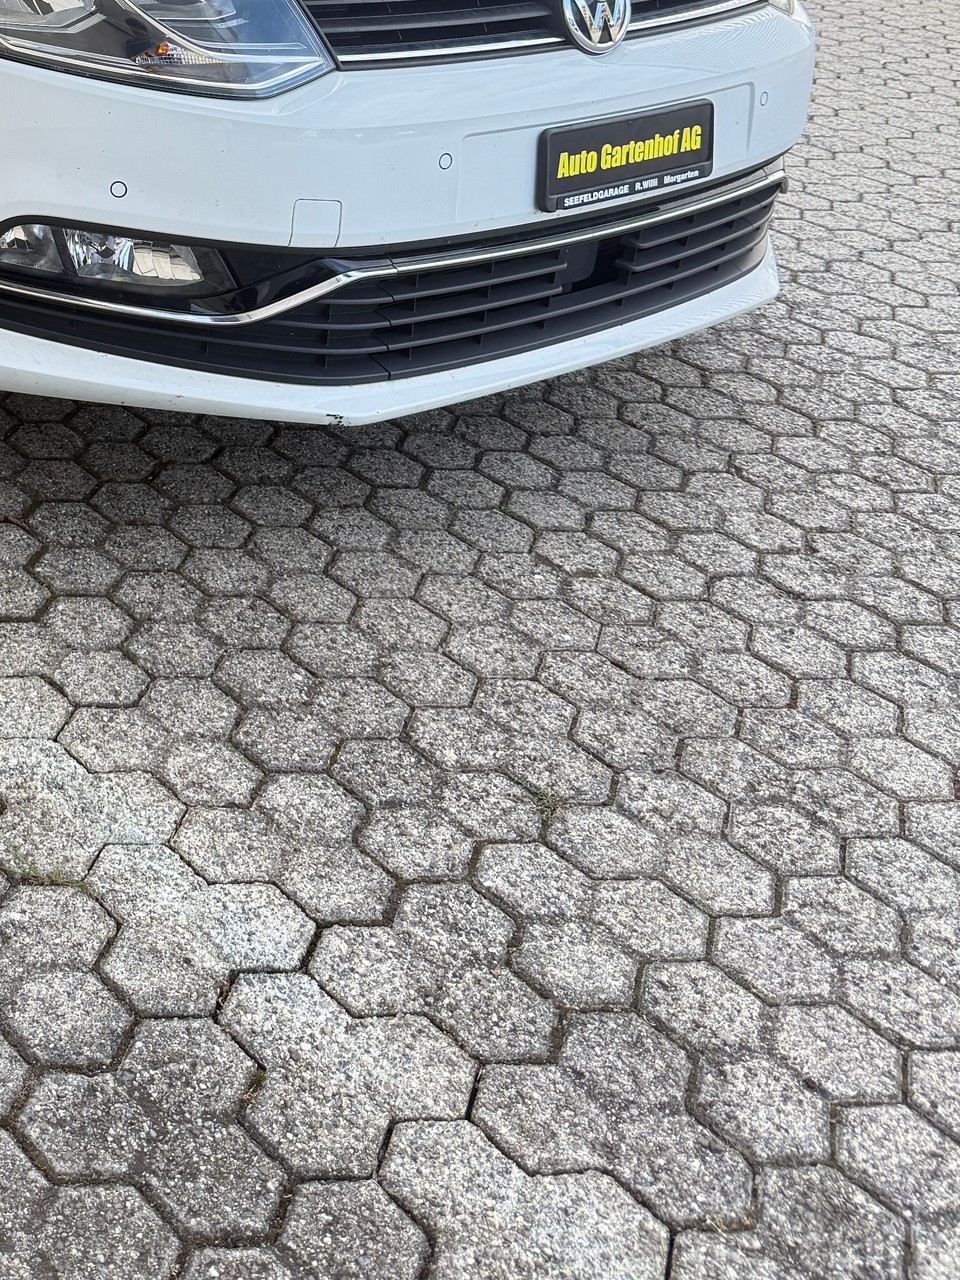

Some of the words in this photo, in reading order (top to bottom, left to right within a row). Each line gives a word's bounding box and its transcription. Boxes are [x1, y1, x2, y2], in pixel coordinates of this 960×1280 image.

[557, 151, 597, 179] Auto
[600, 129, 680, 170] Gartenhof
[680, 125, 701, 153] AG
[564, 184, 629, 207] SEEFELDGARAGE
[663, 170, 699, 184] Morgarten
